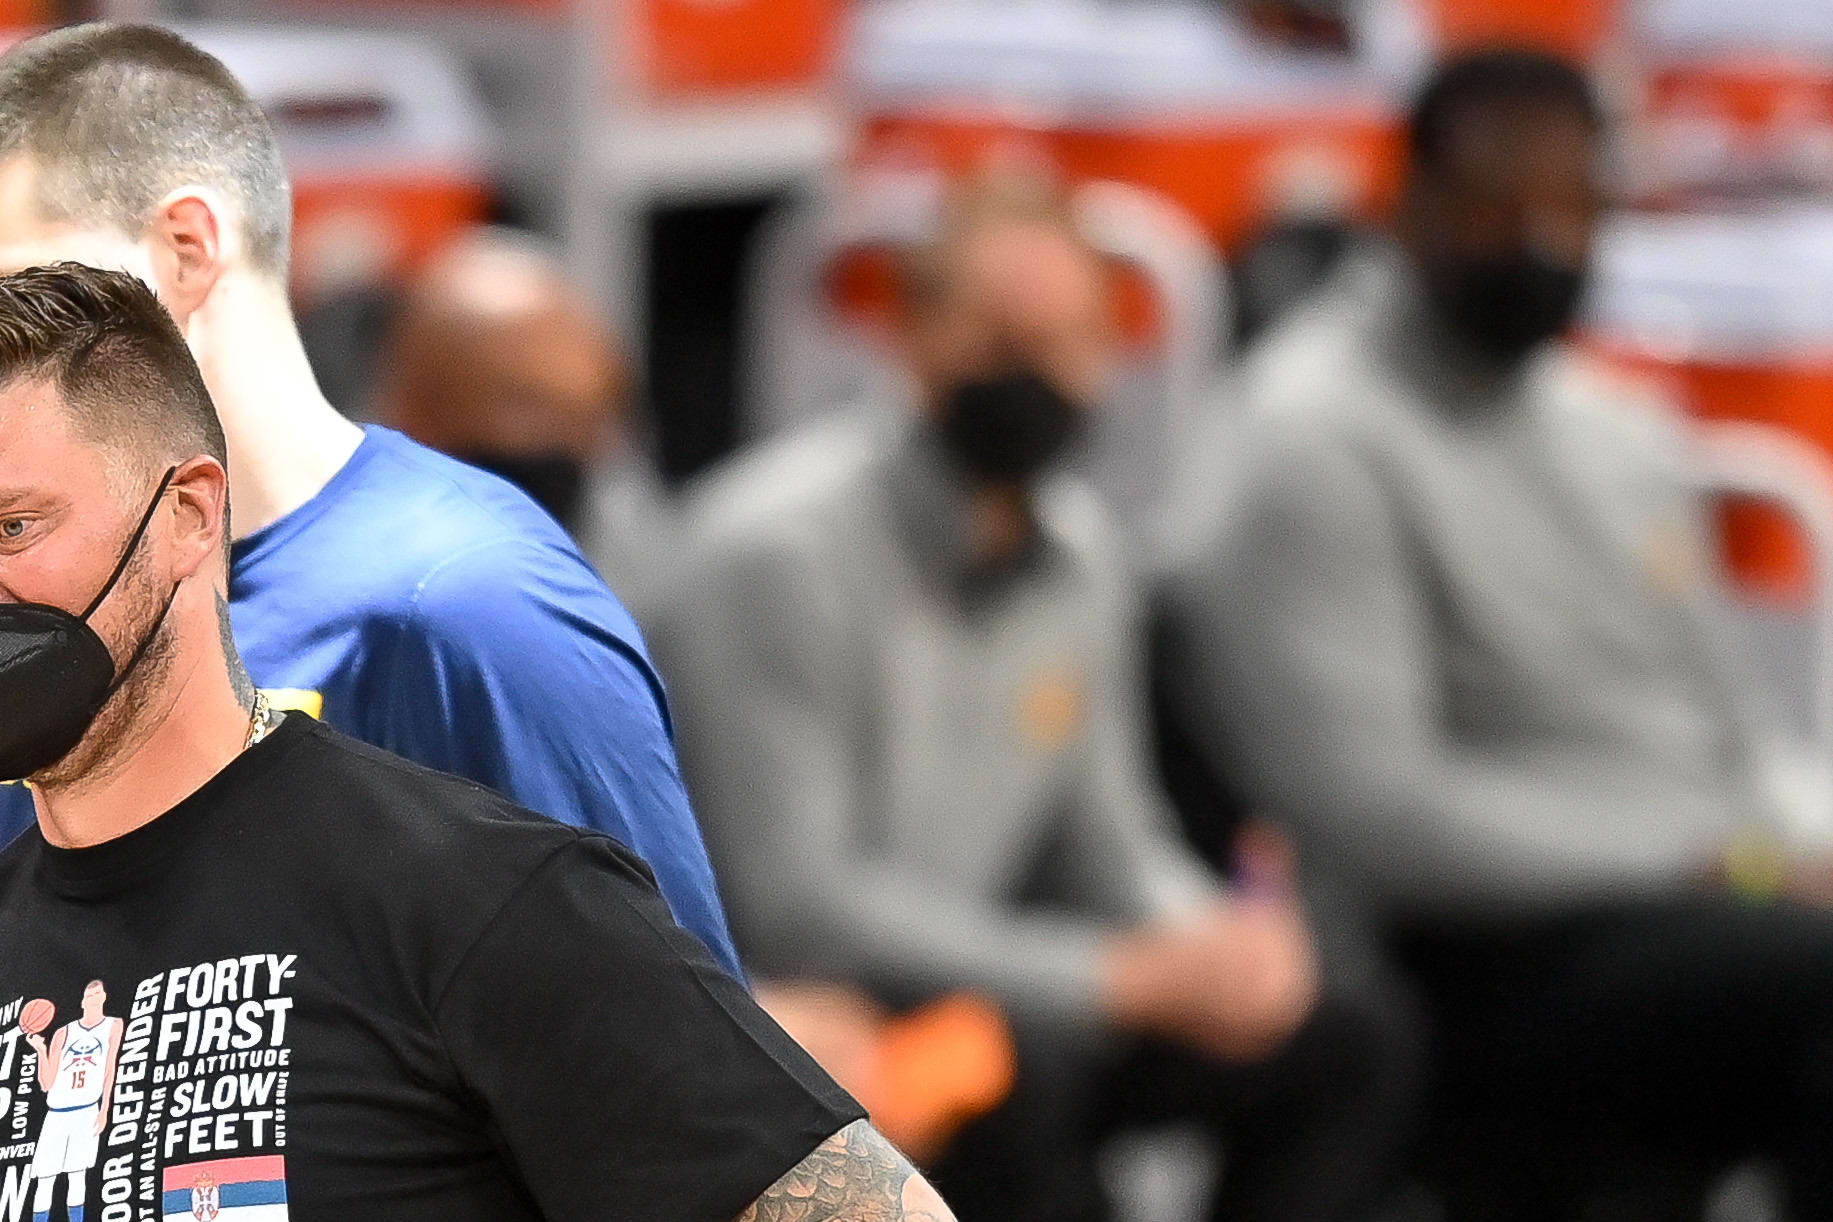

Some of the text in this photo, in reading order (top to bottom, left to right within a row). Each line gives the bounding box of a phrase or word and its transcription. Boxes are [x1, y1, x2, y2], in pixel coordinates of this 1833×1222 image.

[163, 953, 298, 1011] FORTY-
[156, 997, 293, 1061] FIRST
[71, 1070, 86, 1089] 15
[108, 972, 164, 1147] DEFENDER
[152, 1048, 292, 1084] BAD ATTITUDE
[11, 1052, 38, 1140] LOW PICK
[169, 1071, 277, 1118] SLOW
[140, 1086, 167, 1172] ALL-STAR
[164, 1110, 274, 1159] FEET
[274, 1124, 286, 1147] OUT
[139, 1176, 155, 1201] AN
